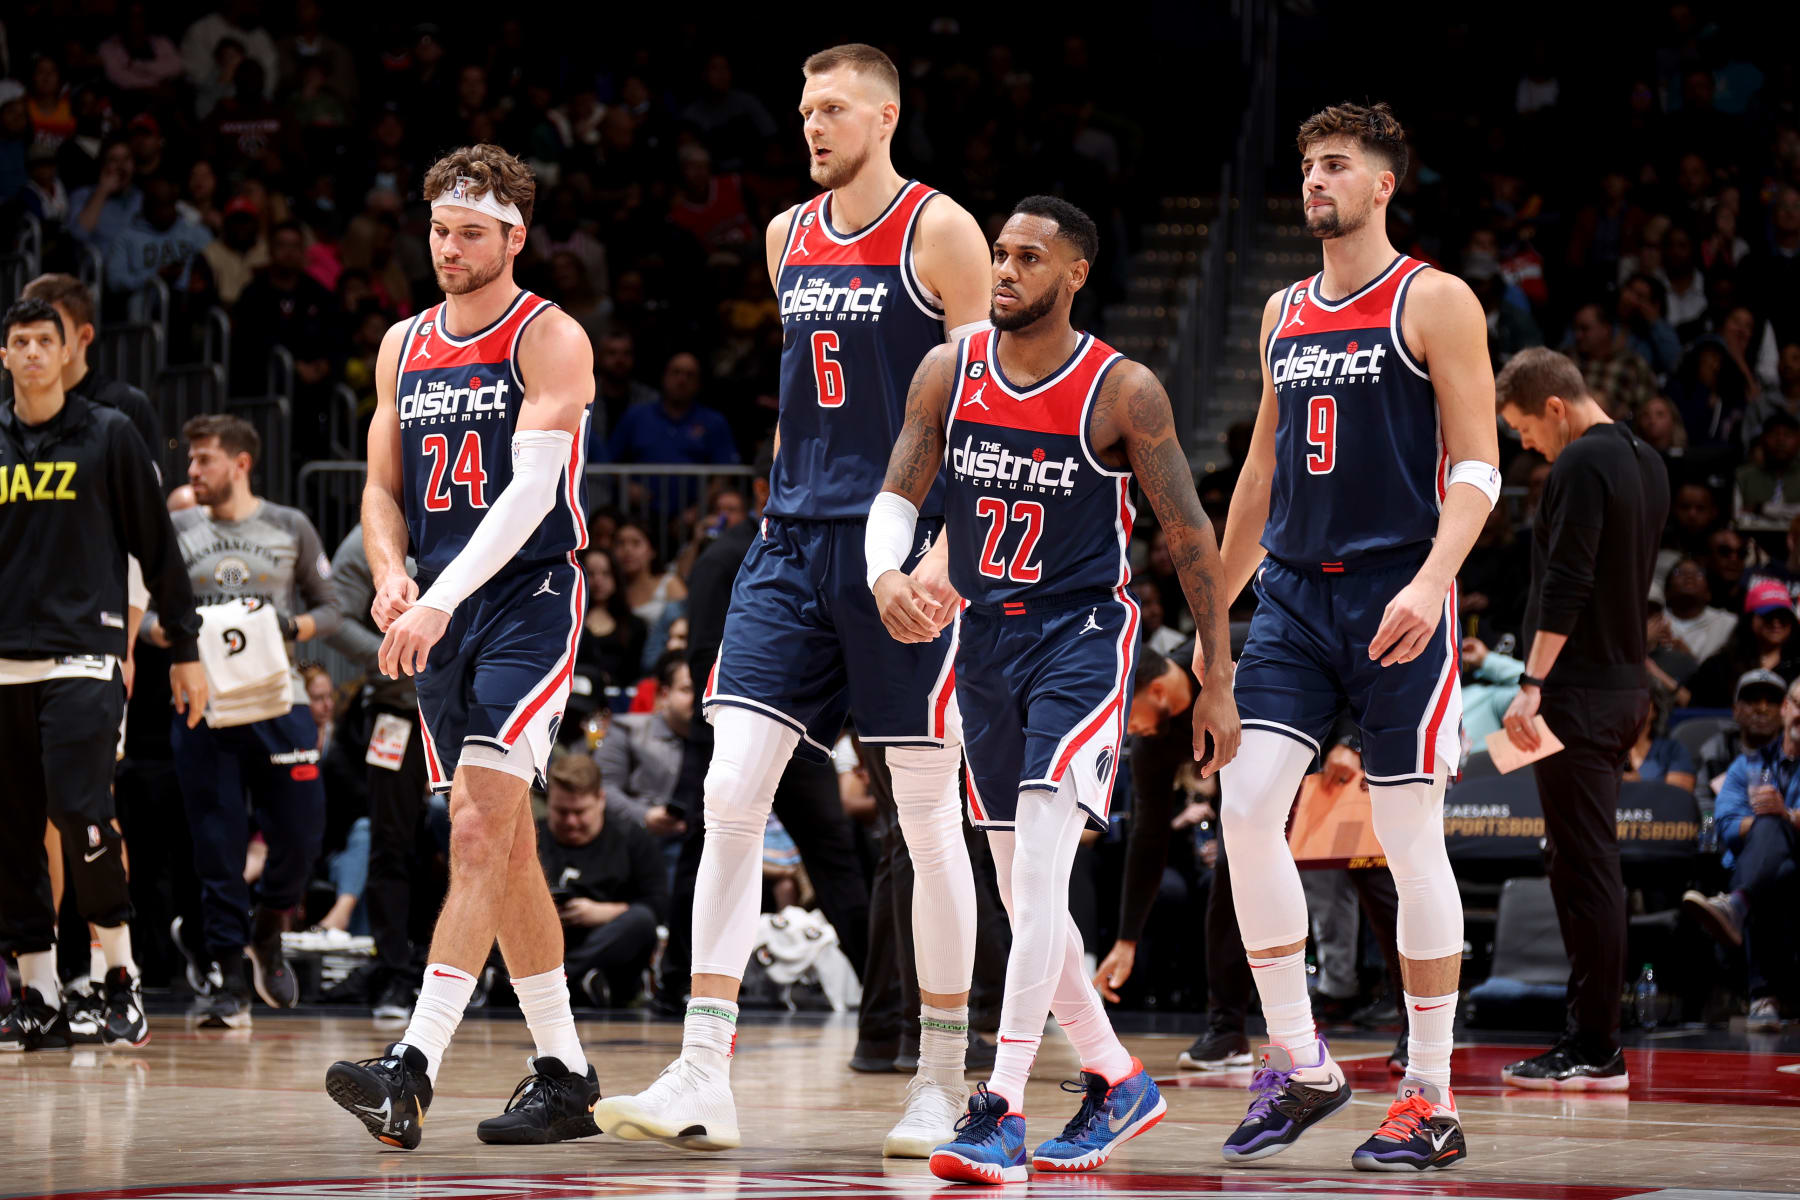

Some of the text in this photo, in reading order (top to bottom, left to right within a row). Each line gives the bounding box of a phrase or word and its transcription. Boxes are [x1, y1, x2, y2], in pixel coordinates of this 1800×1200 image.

[802, 211, 816, 226] 6
[807, 278, 825, 288] THE
[781, 274, 889, 316] district
[1293, 289, 1307, 304] 6
[795, 313, 880, 323] COLUMBIA
[420, 322, 434, 336] 6
[1302, 344, 1321, 356] THE
[810, 329, 846, 408] 6
[968, 362, 984, 378] 6
[1273, 340, 1387, 385] district
[427, 380, 447, 393] THE
[1291, 375, 1380, 389] COLUMBIA
[400, 376, 509, 421] district
[420, 410, 506, 426] COLUMBIA
[1306, 394, 1338, 475] 9
[979, 440, 1002, 452] THE
[952, 434, 1080, 489] district
[422, 430, 490, 513] 24
[0, 461, 78, 505] JAZZ
[972, 478, 1073, 497] COLUMBIA
[976, 496, 1045, 584] 22
